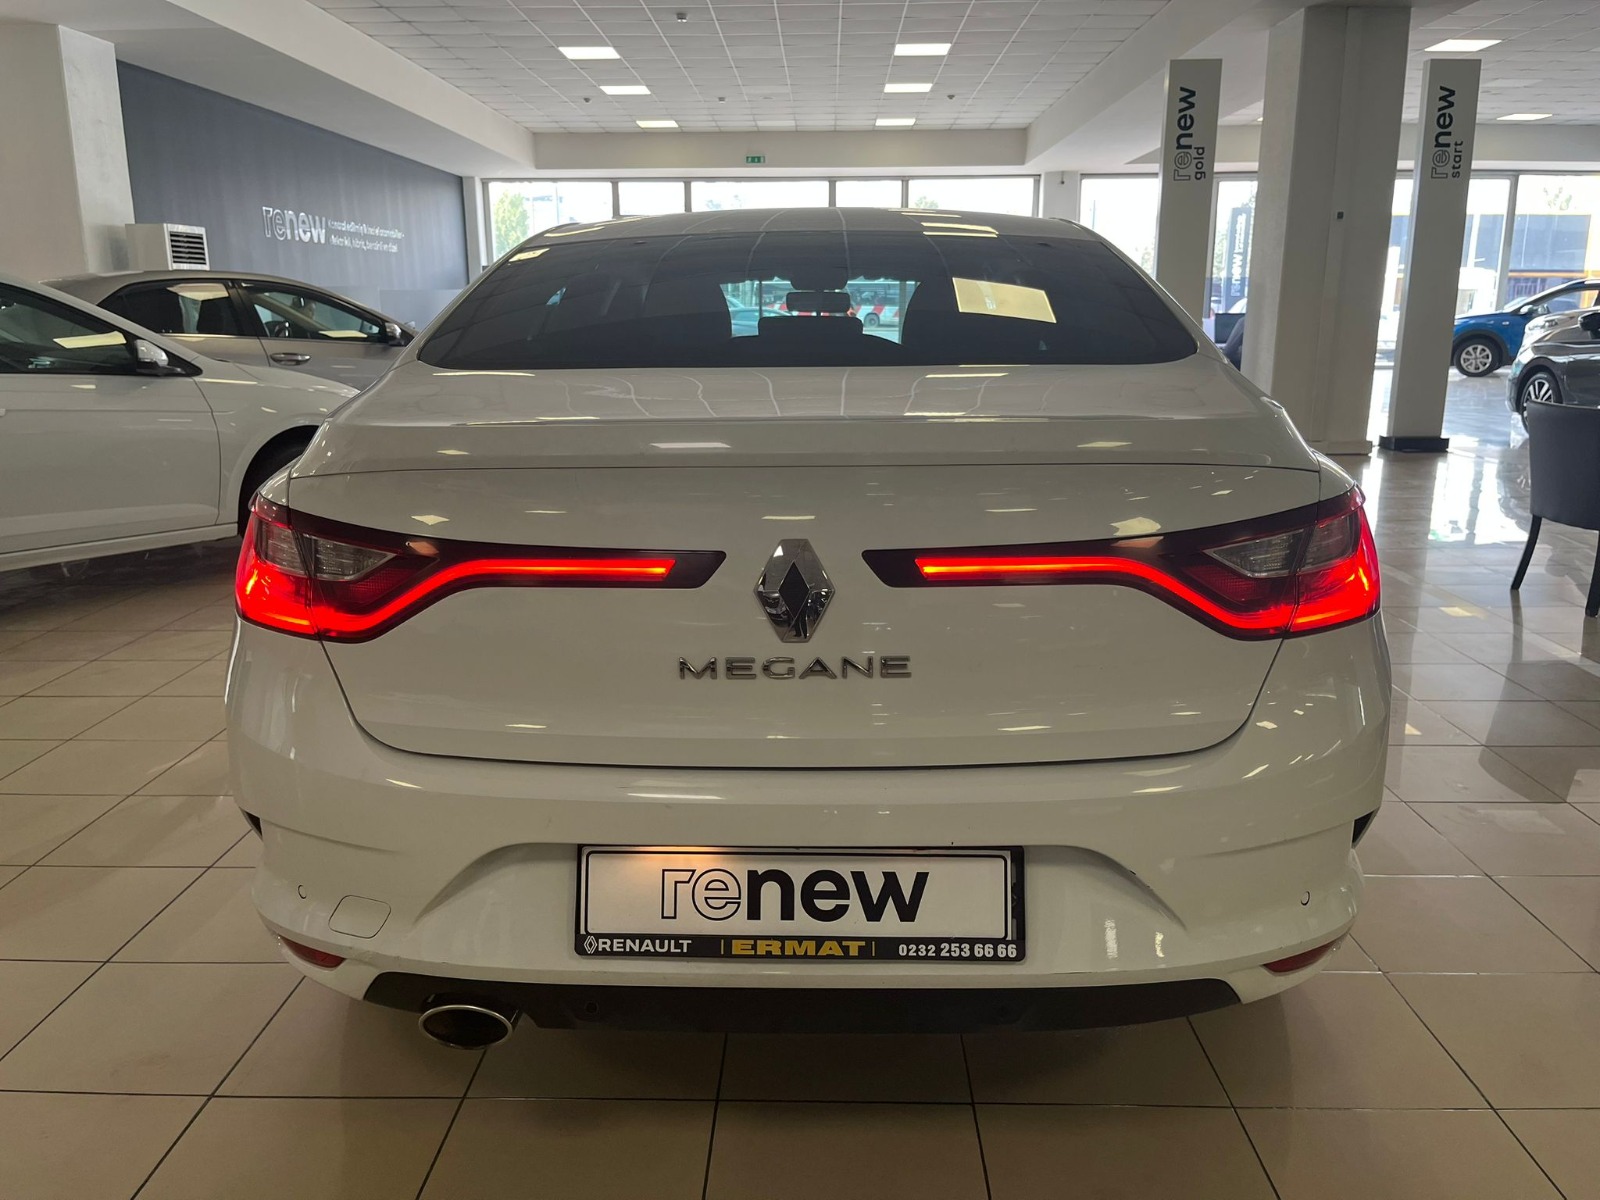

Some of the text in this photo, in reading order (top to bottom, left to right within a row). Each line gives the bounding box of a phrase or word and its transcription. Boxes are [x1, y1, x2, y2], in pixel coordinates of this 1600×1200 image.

[1173, 86, 1197, 182] renew
[1430, 85, 1457, 179] renew
[1192, 146, 1206, 181] gold
[1451, 140, 1464, 179] start
[262, 206, 326, 244] renew
[679, 655, 912, 680] MEGANE
[660, 868, 930, 923] renew
[598, 938, 1018, 958] RENAULT ERMAT 0232 253 66 66
